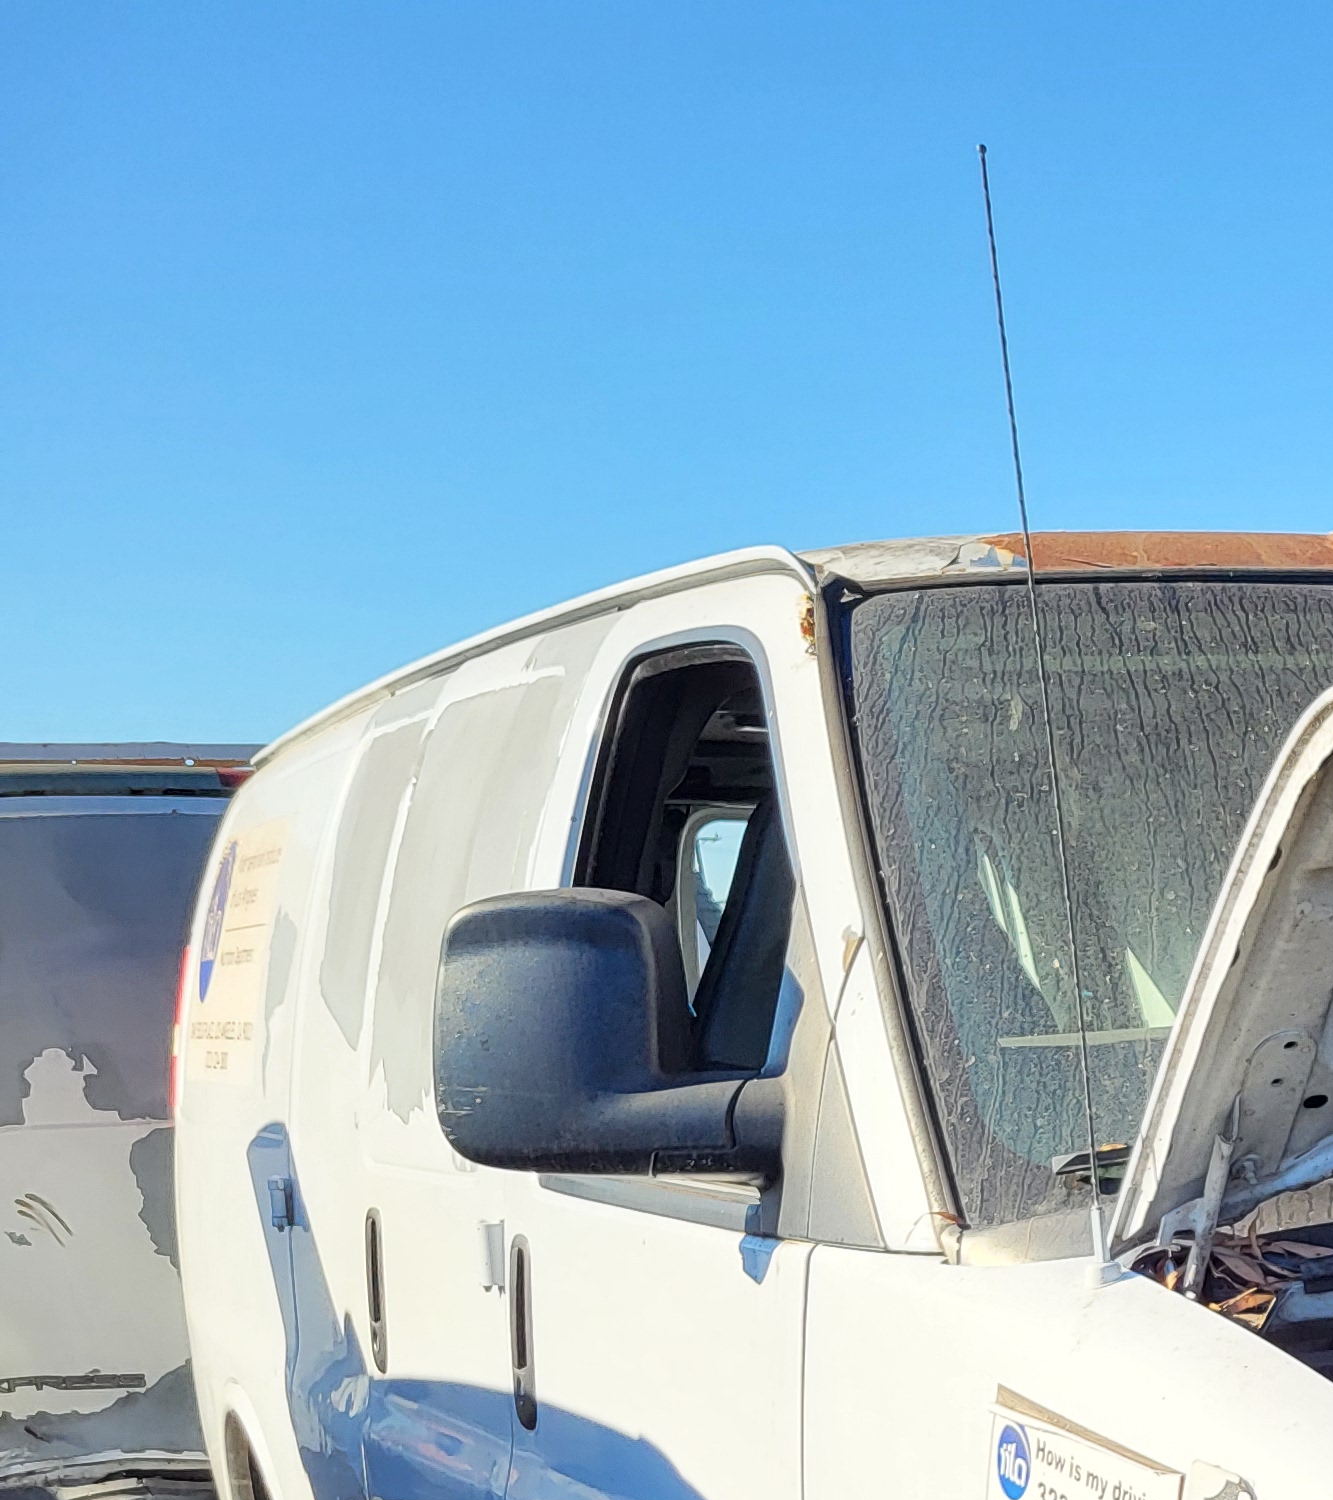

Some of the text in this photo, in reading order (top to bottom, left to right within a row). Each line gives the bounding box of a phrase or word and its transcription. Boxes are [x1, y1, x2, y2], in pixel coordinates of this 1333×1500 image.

[1036, 1437, 1066, 1473] How
[1069, 1455, 1081, 1482] is
[1086, 1470, 1108, 1500] my
